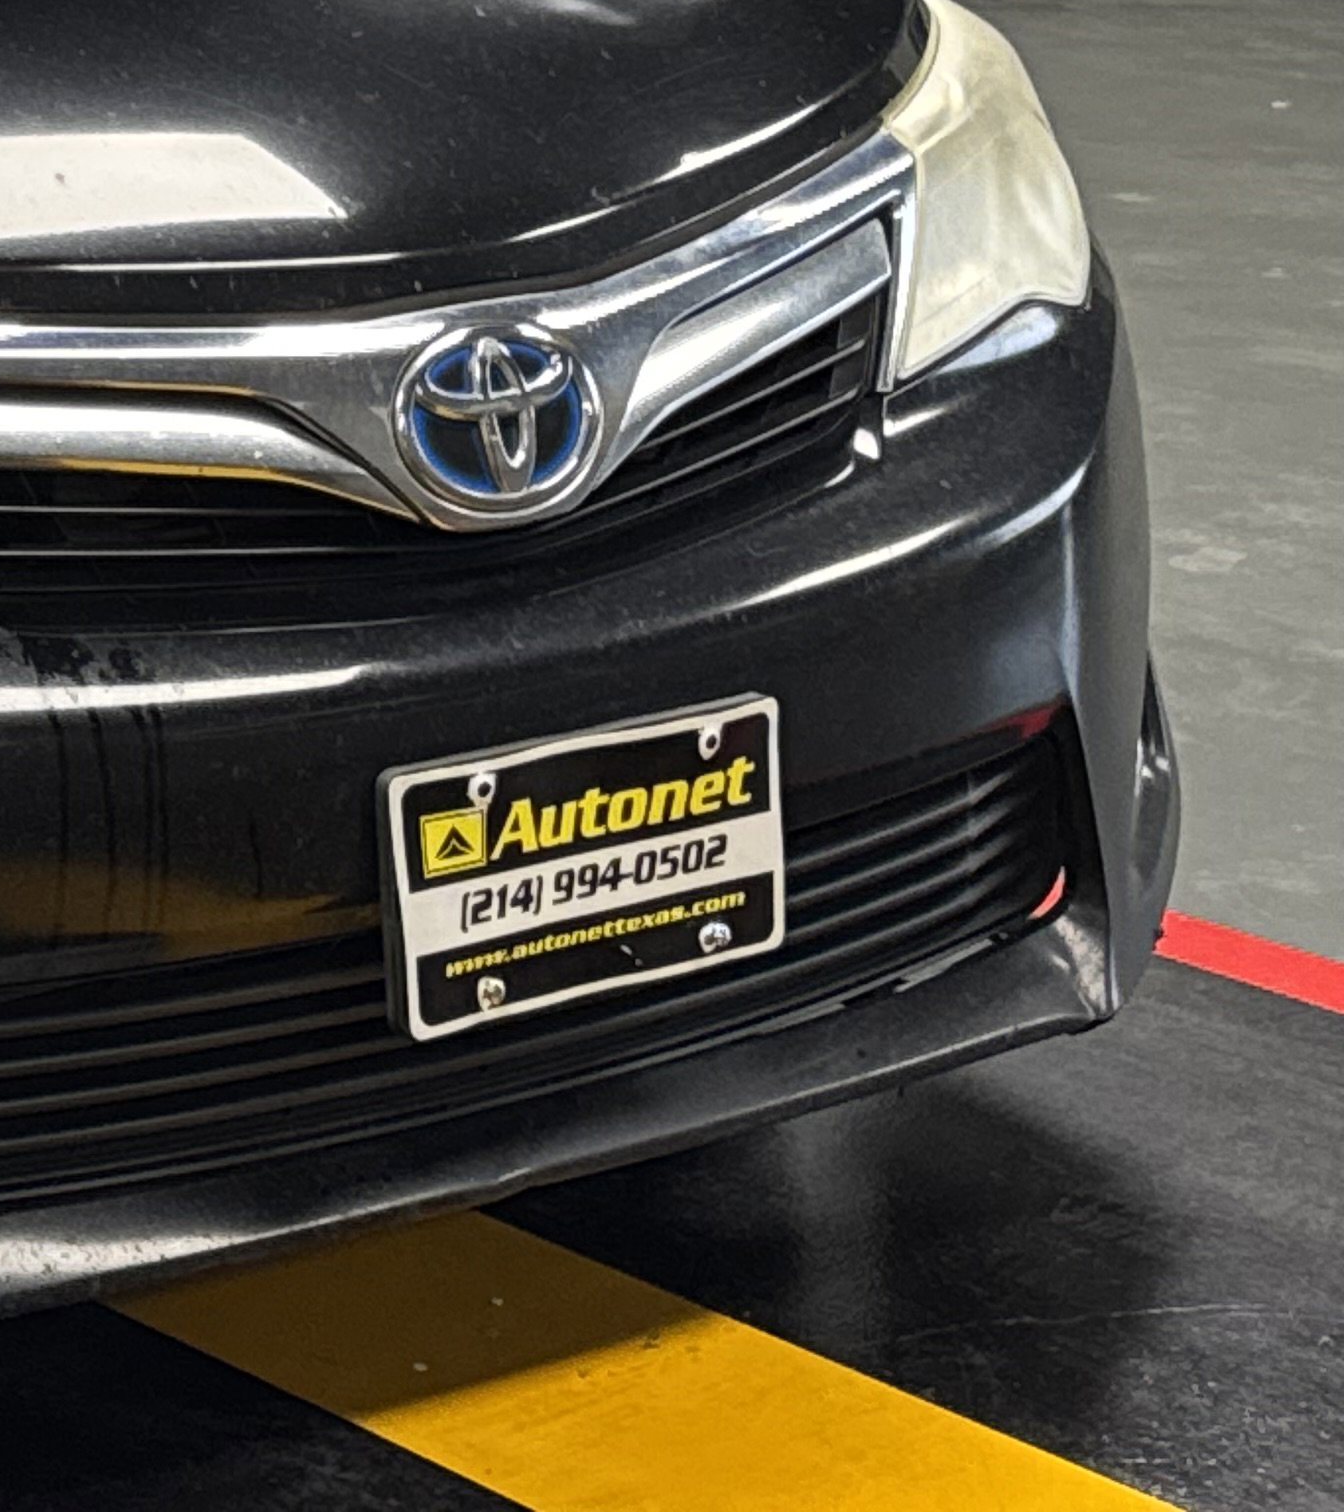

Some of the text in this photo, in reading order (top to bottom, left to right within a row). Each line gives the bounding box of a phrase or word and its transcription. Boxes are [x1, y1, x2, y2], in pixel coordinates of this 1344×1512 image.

[490, 755, 756, 861] Autonet
[445, 890, 746, 978] www.autonettexas.com
[460, 834, 728, 934] (214) 994-0502
